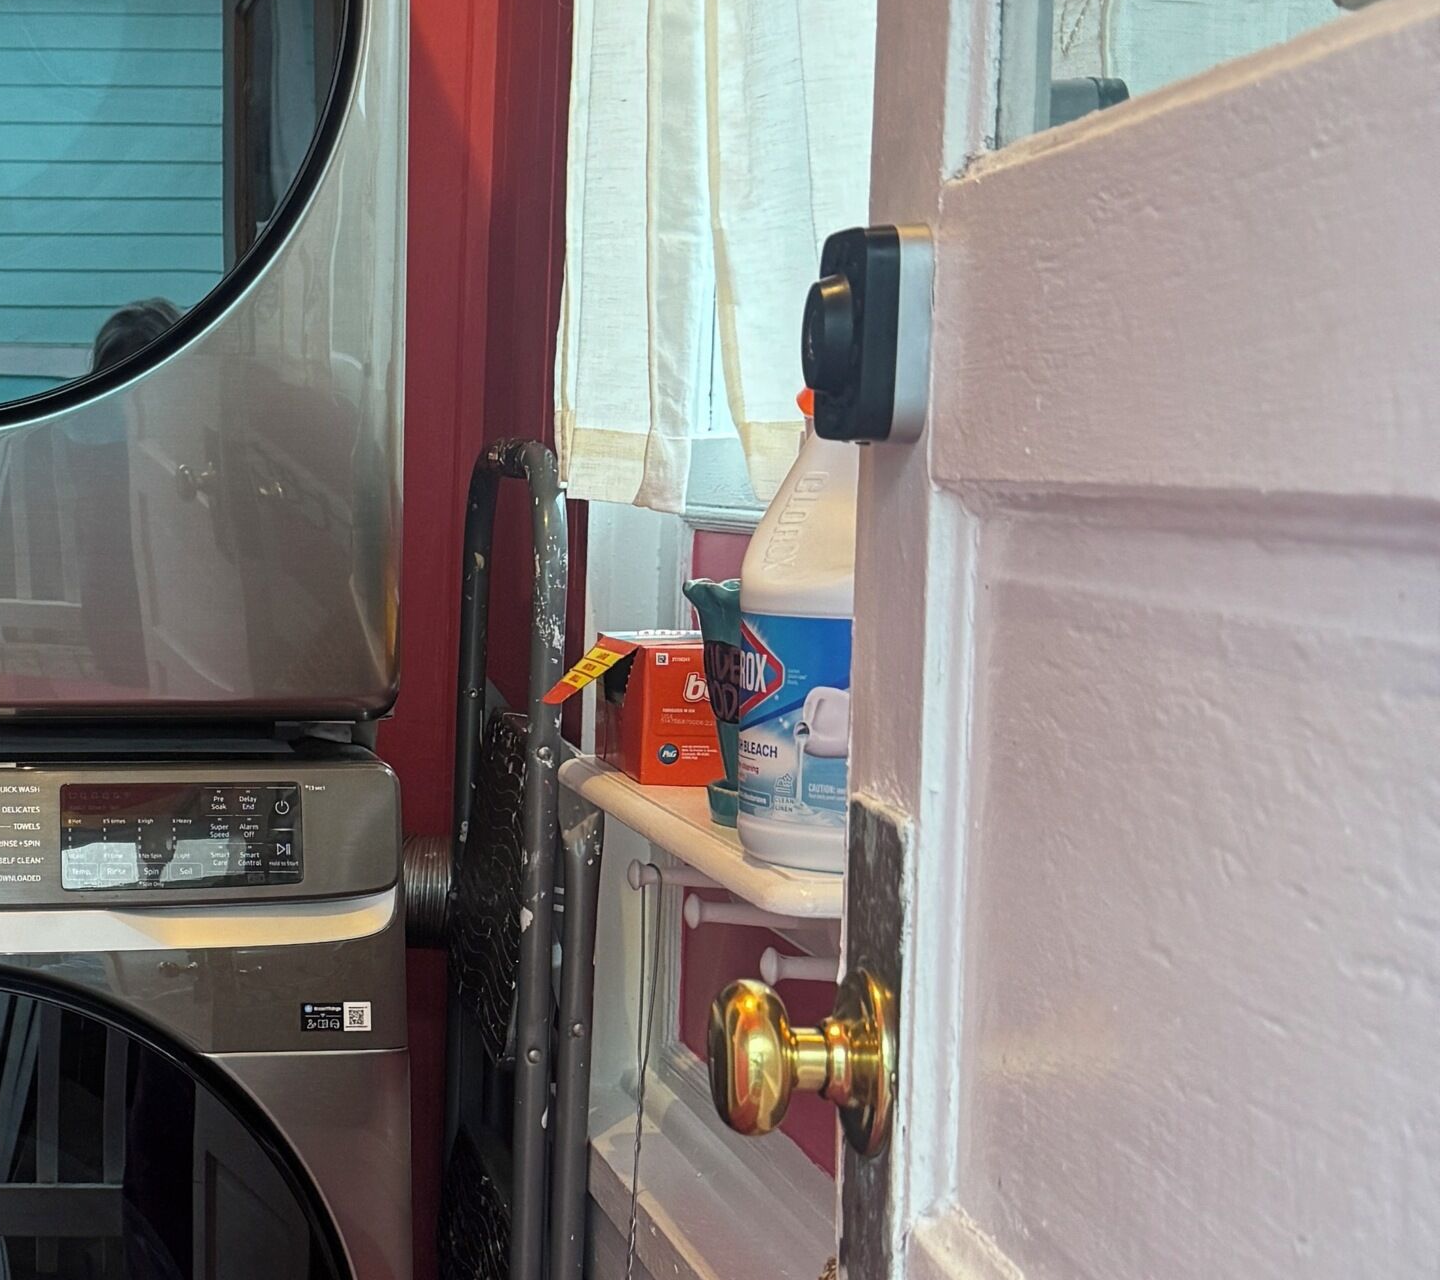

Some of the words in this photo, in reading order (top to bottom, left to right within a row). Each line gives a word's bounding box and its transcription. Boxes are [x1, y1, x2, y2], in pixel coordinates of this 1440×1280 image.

[743, 740, 778, 759] BLEACH
[238, 795, 257, 804] Delay
[1, 806, 41, 814] DELICATES
[13, 822, 41, 830] TOWELS
[210, 823, 229, 831] Super
[210, 831, 230, 839] Speed
[243, 830, 255, 838] Off
[238, 859, 262, 867] Control
[143, 867, 160, 876] Spin
[179, 867, 193, 875] Soil
